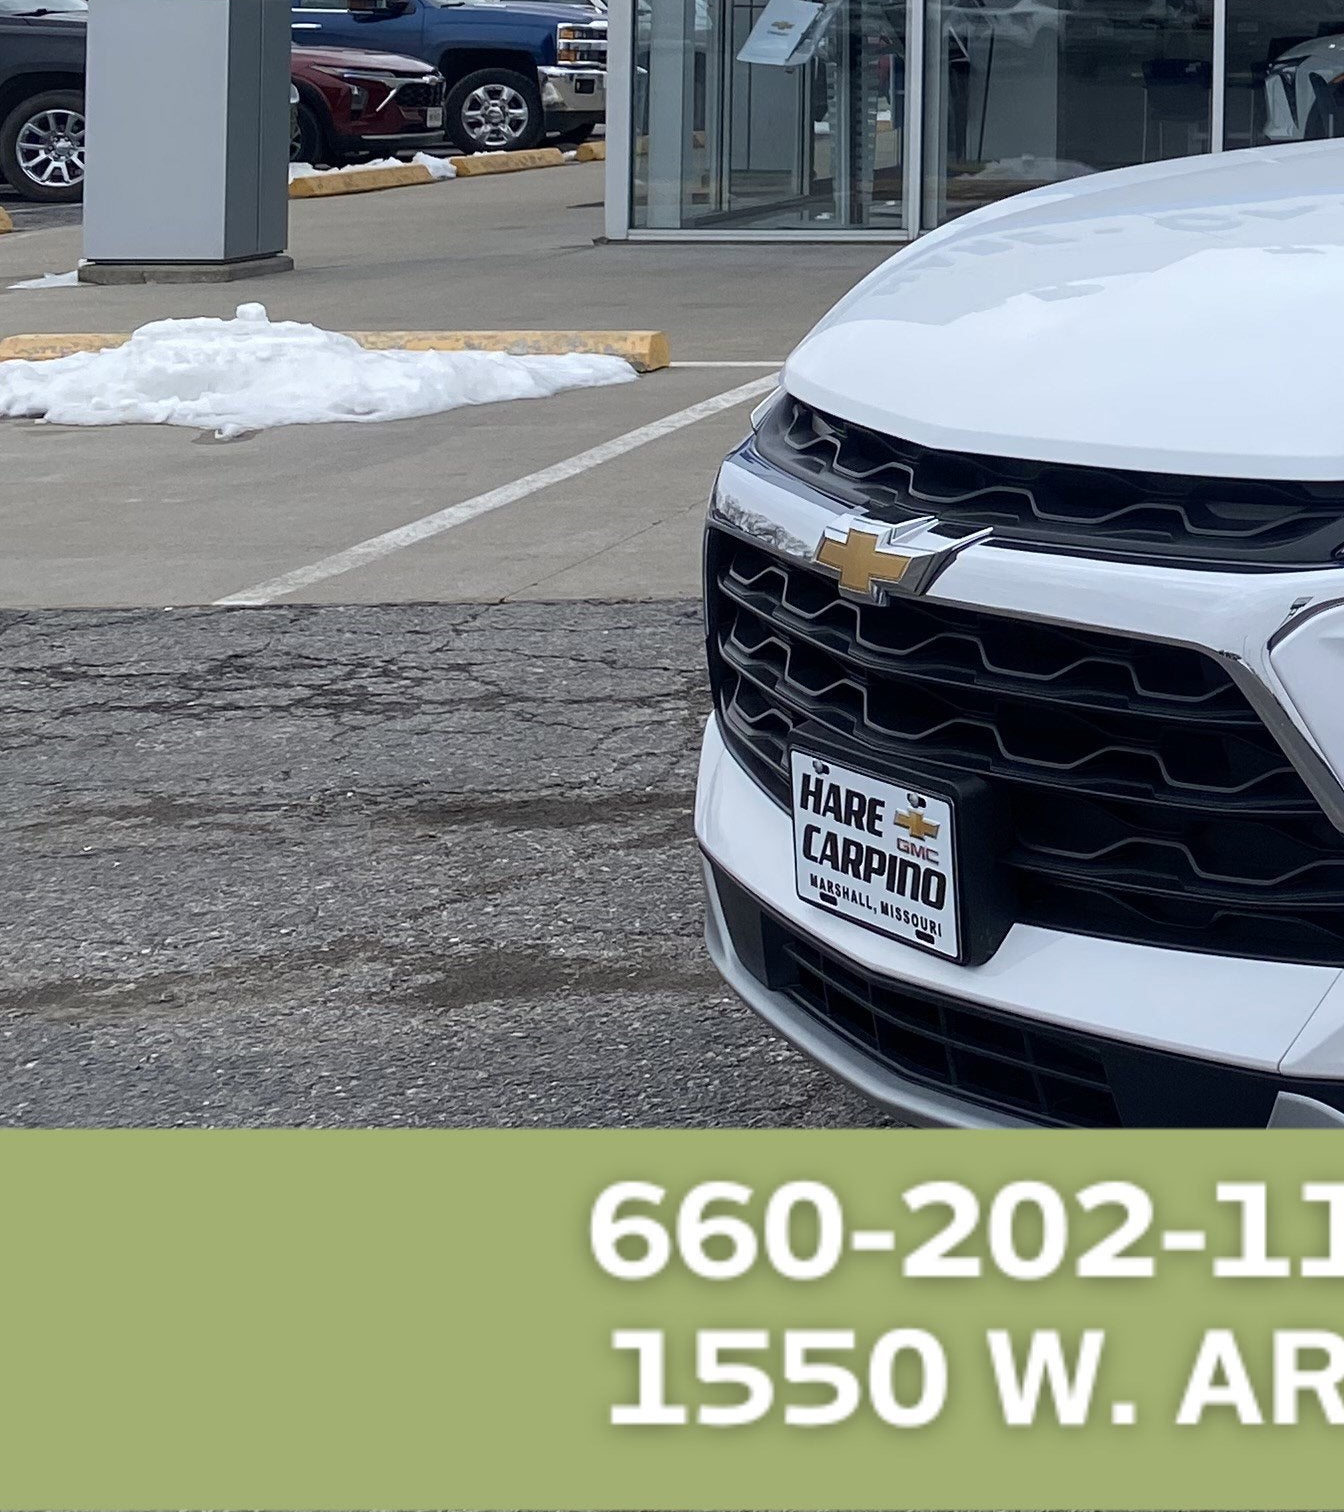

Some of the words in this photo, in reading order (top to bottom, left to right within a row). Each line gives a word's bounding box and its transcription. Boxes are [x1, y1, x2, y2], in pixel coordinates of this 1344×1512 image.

[800, 773, 886, 837] HARE
[802, 823, 947, 912] CARPINO
[895, 836, 941, 866] GMC
[809, 872, 878, 915] MARSHALL,
[880, 899, 943, 939] MISSOURI
